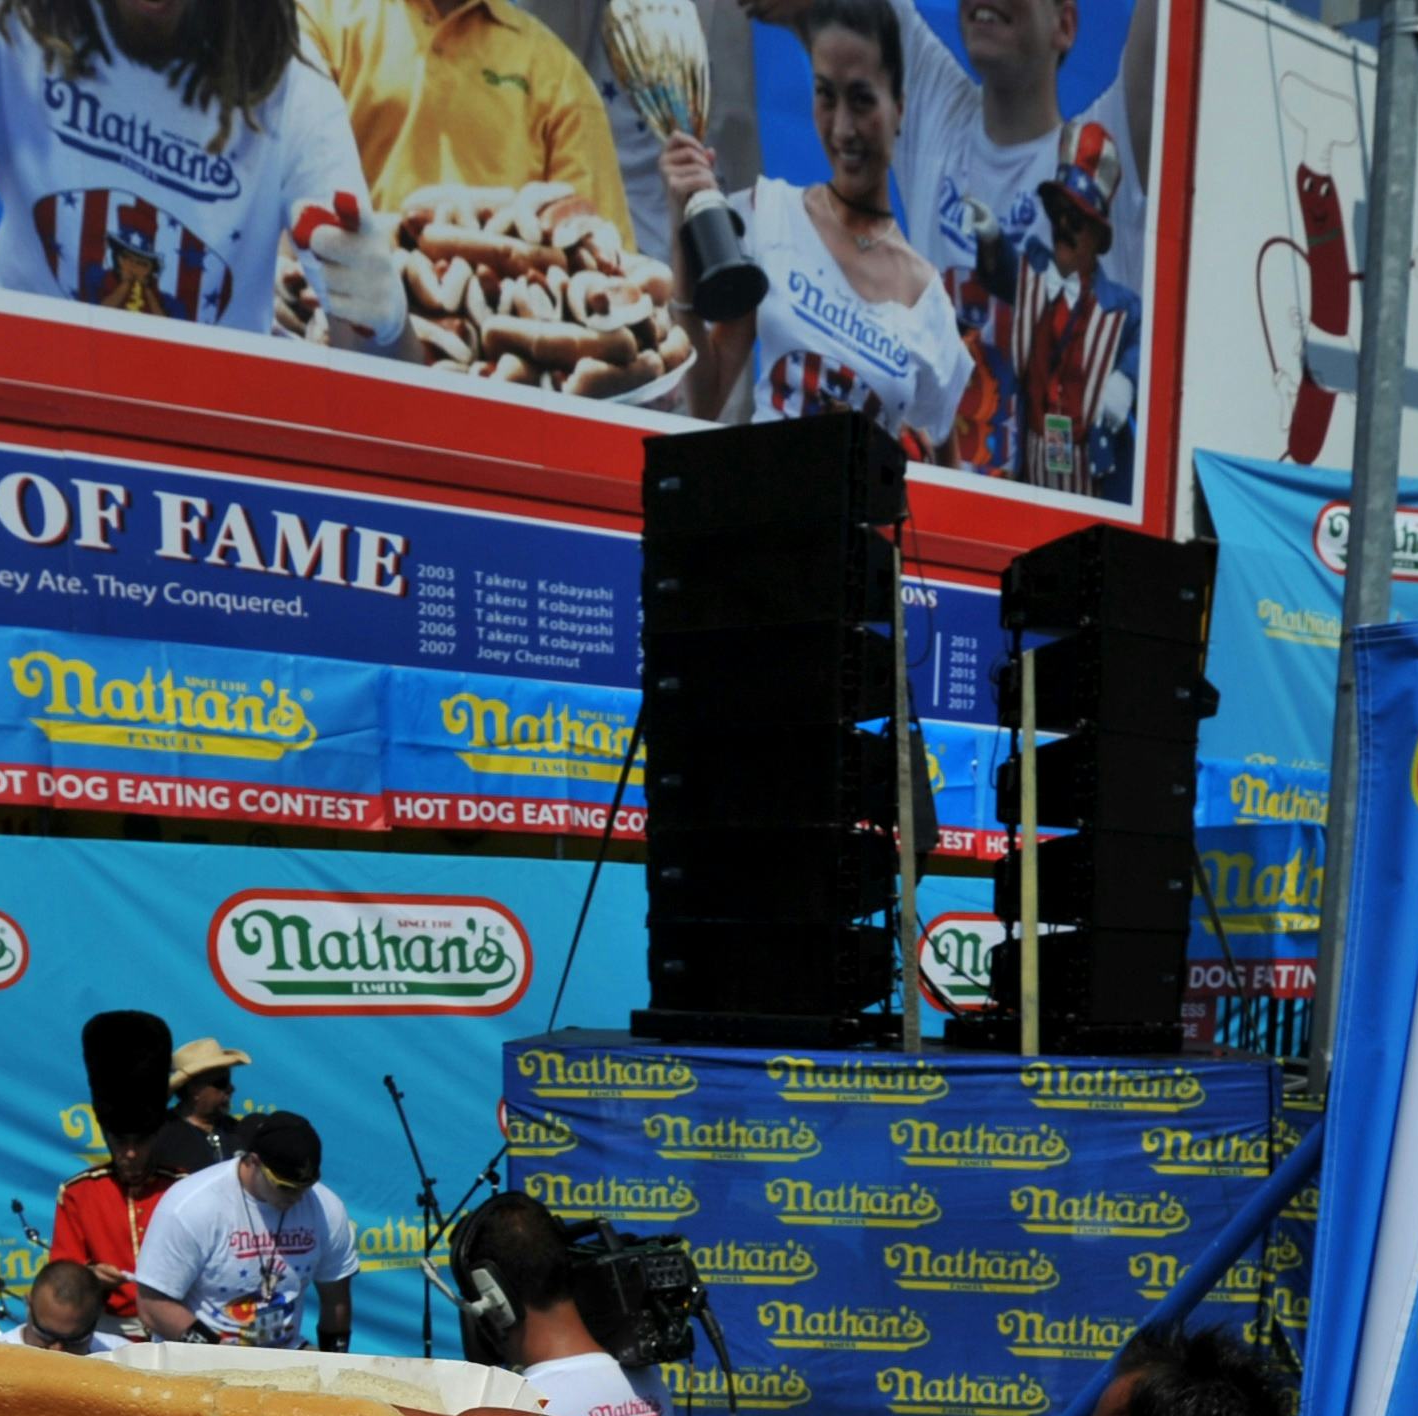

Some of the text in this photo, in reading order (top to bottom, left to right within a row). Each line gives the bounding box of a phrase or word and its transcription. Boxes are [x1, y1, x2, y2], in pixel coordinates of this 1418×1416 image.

[44, 76, 240, 190] Nathan's
[788, 269, 910, 367] Nathan's
[152, 490, 410, 597] FAME
[38, 569, 90, 597] Ate.
[96, 574, 159, 609] They
[163, 581, 310, 619] Conquered.
[417, 563, 614, 602] 2003 Takeru Kobayashi
[417, 583, 614, 620] 2004 Takeru Kobayashi
[417, 601, 614, 638] 2005 Takeru Kobayashi
[418, 620, 615, 656] 2006 Takeru Kobayashi
[419, 639, 581, 670] 2007 Joey Chestnut
[8, 650, 318, 737] Nathan's
[38, 771, 109, 801] DOG
[117, 778, 231, 811] EATING
[238, 788, 370, 823] CONTEST
[393, 796, 451, 821] HOT
[457, 798, 516, 824] DOG
[522, 803, 608, 829] EATING
[234, 908, 516, 975] Nathan's
[1189, 964, 1318, 990] DOG EATIN
[516, 1049, 698, 1089] Nathan's
[765, 1055, 950, 1094] Nathan's
[1019, 1061, 1206, 1101] Nathan's
[642, 1112, 822, 1150] Nathan's
[889, 1118, 1071, 1157] Nathan's
[523, 1172, 700, 1210] Nathan's
[764, 1177, 942, 1218] Nathan's
[1009, 1185, 1191, 1226] Nathan's
[884, 1241, 1061, 1283] Nathan's
[757, 1300, 931, 1340] Nathan's
[875, 1366, 1051, 1407] Nathan's
